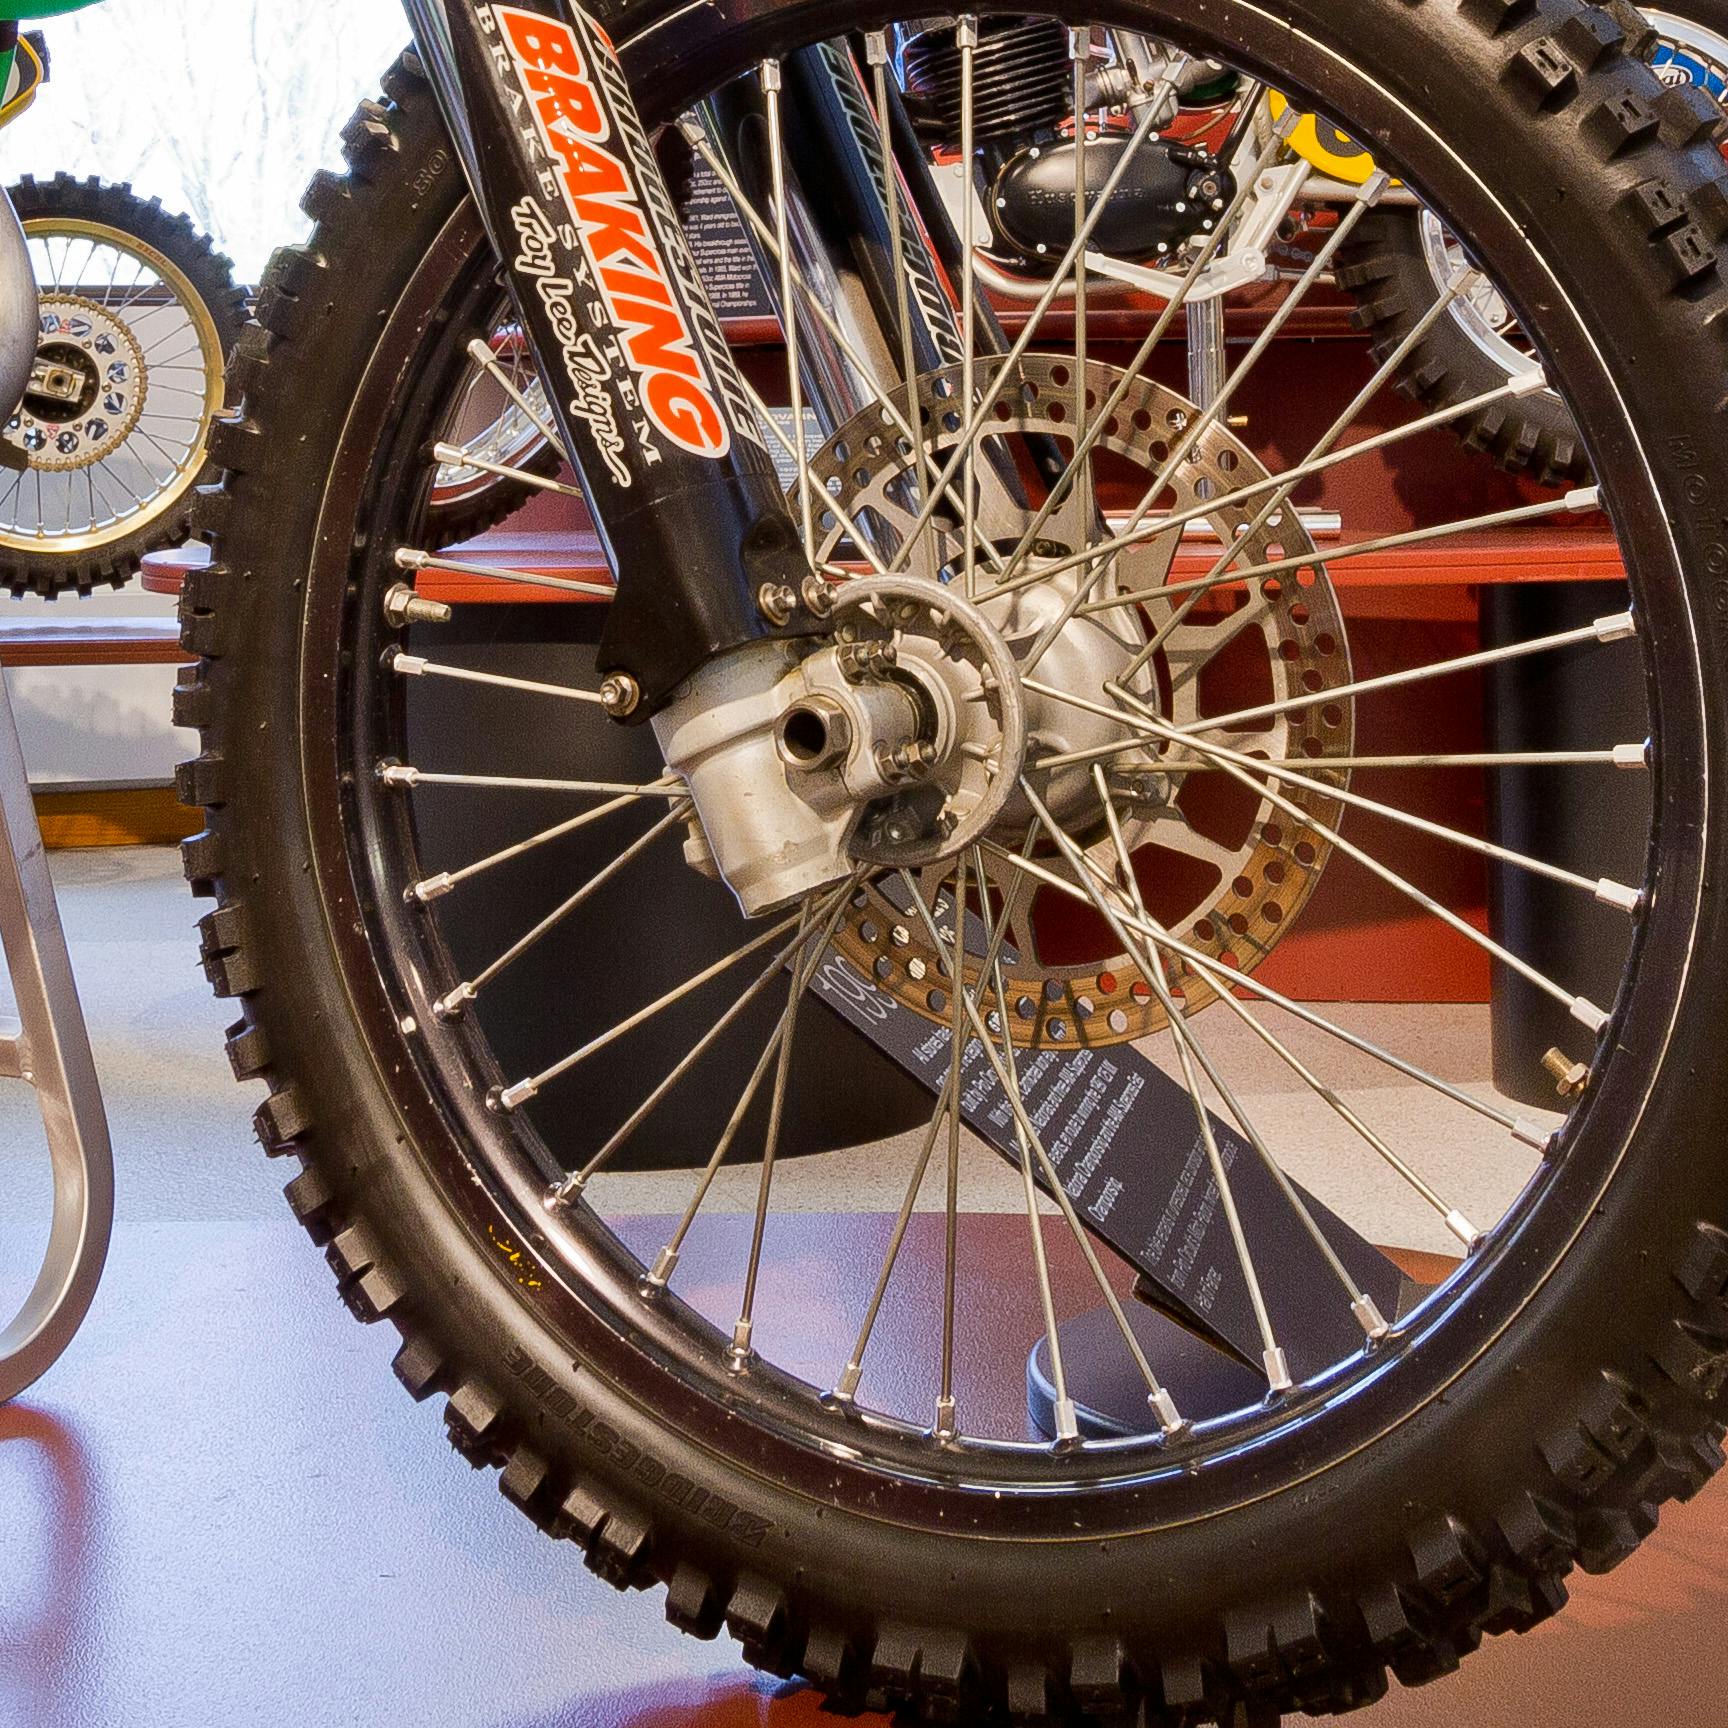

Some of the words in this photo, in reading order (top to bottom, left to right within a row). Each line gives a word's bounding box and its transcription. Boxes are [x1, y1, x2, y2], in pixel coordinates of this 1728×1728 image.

[476, 3, 559, 202] BRAKE
[557, 222, 663, 468] SYSTEM
[491, 2, 732, 459] BRAKING
[512, 197, 556, 278] Troy
[535, 274, 580, 362] Lee
[564, 334, 633, 488] Designs
